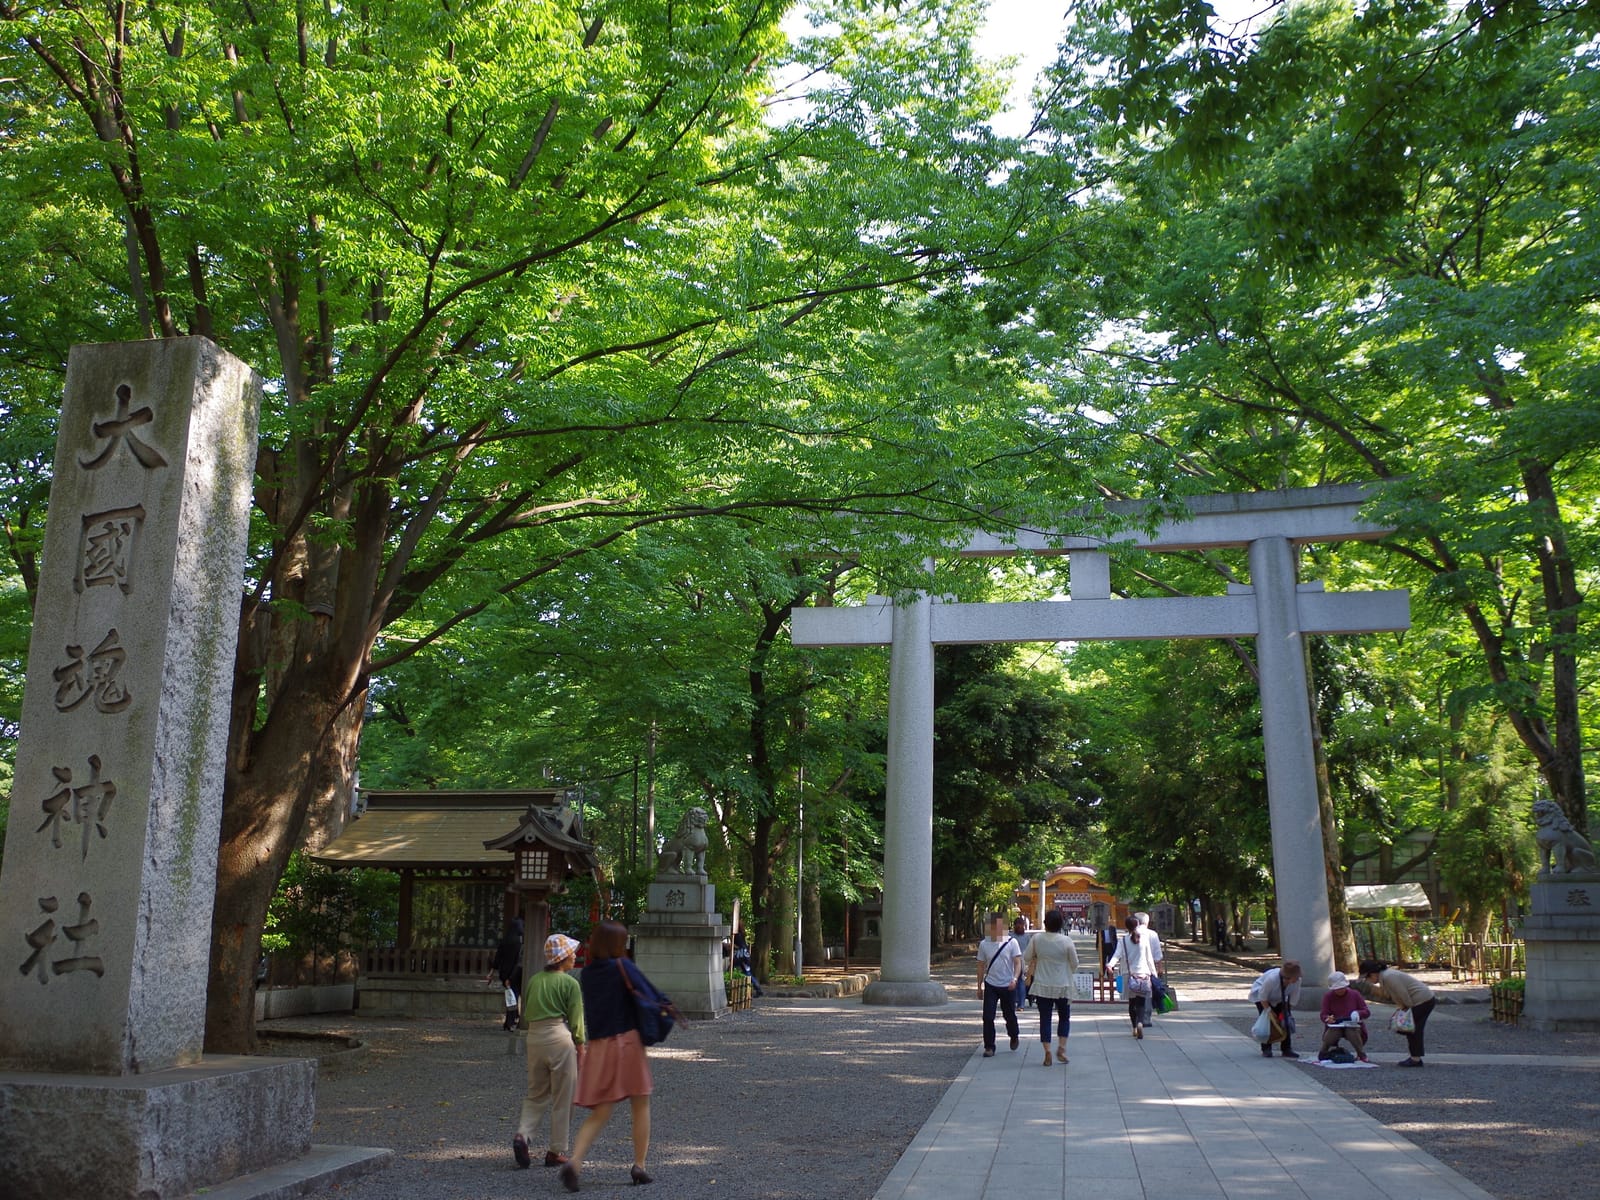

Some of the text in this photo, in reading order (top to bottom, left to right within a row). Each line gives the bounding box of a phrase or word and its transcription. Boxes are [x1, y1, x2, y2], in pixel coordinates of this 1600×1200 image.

[19, 383, 168, 985] 大國魂神社
[665, 888, 685, 907] 納
